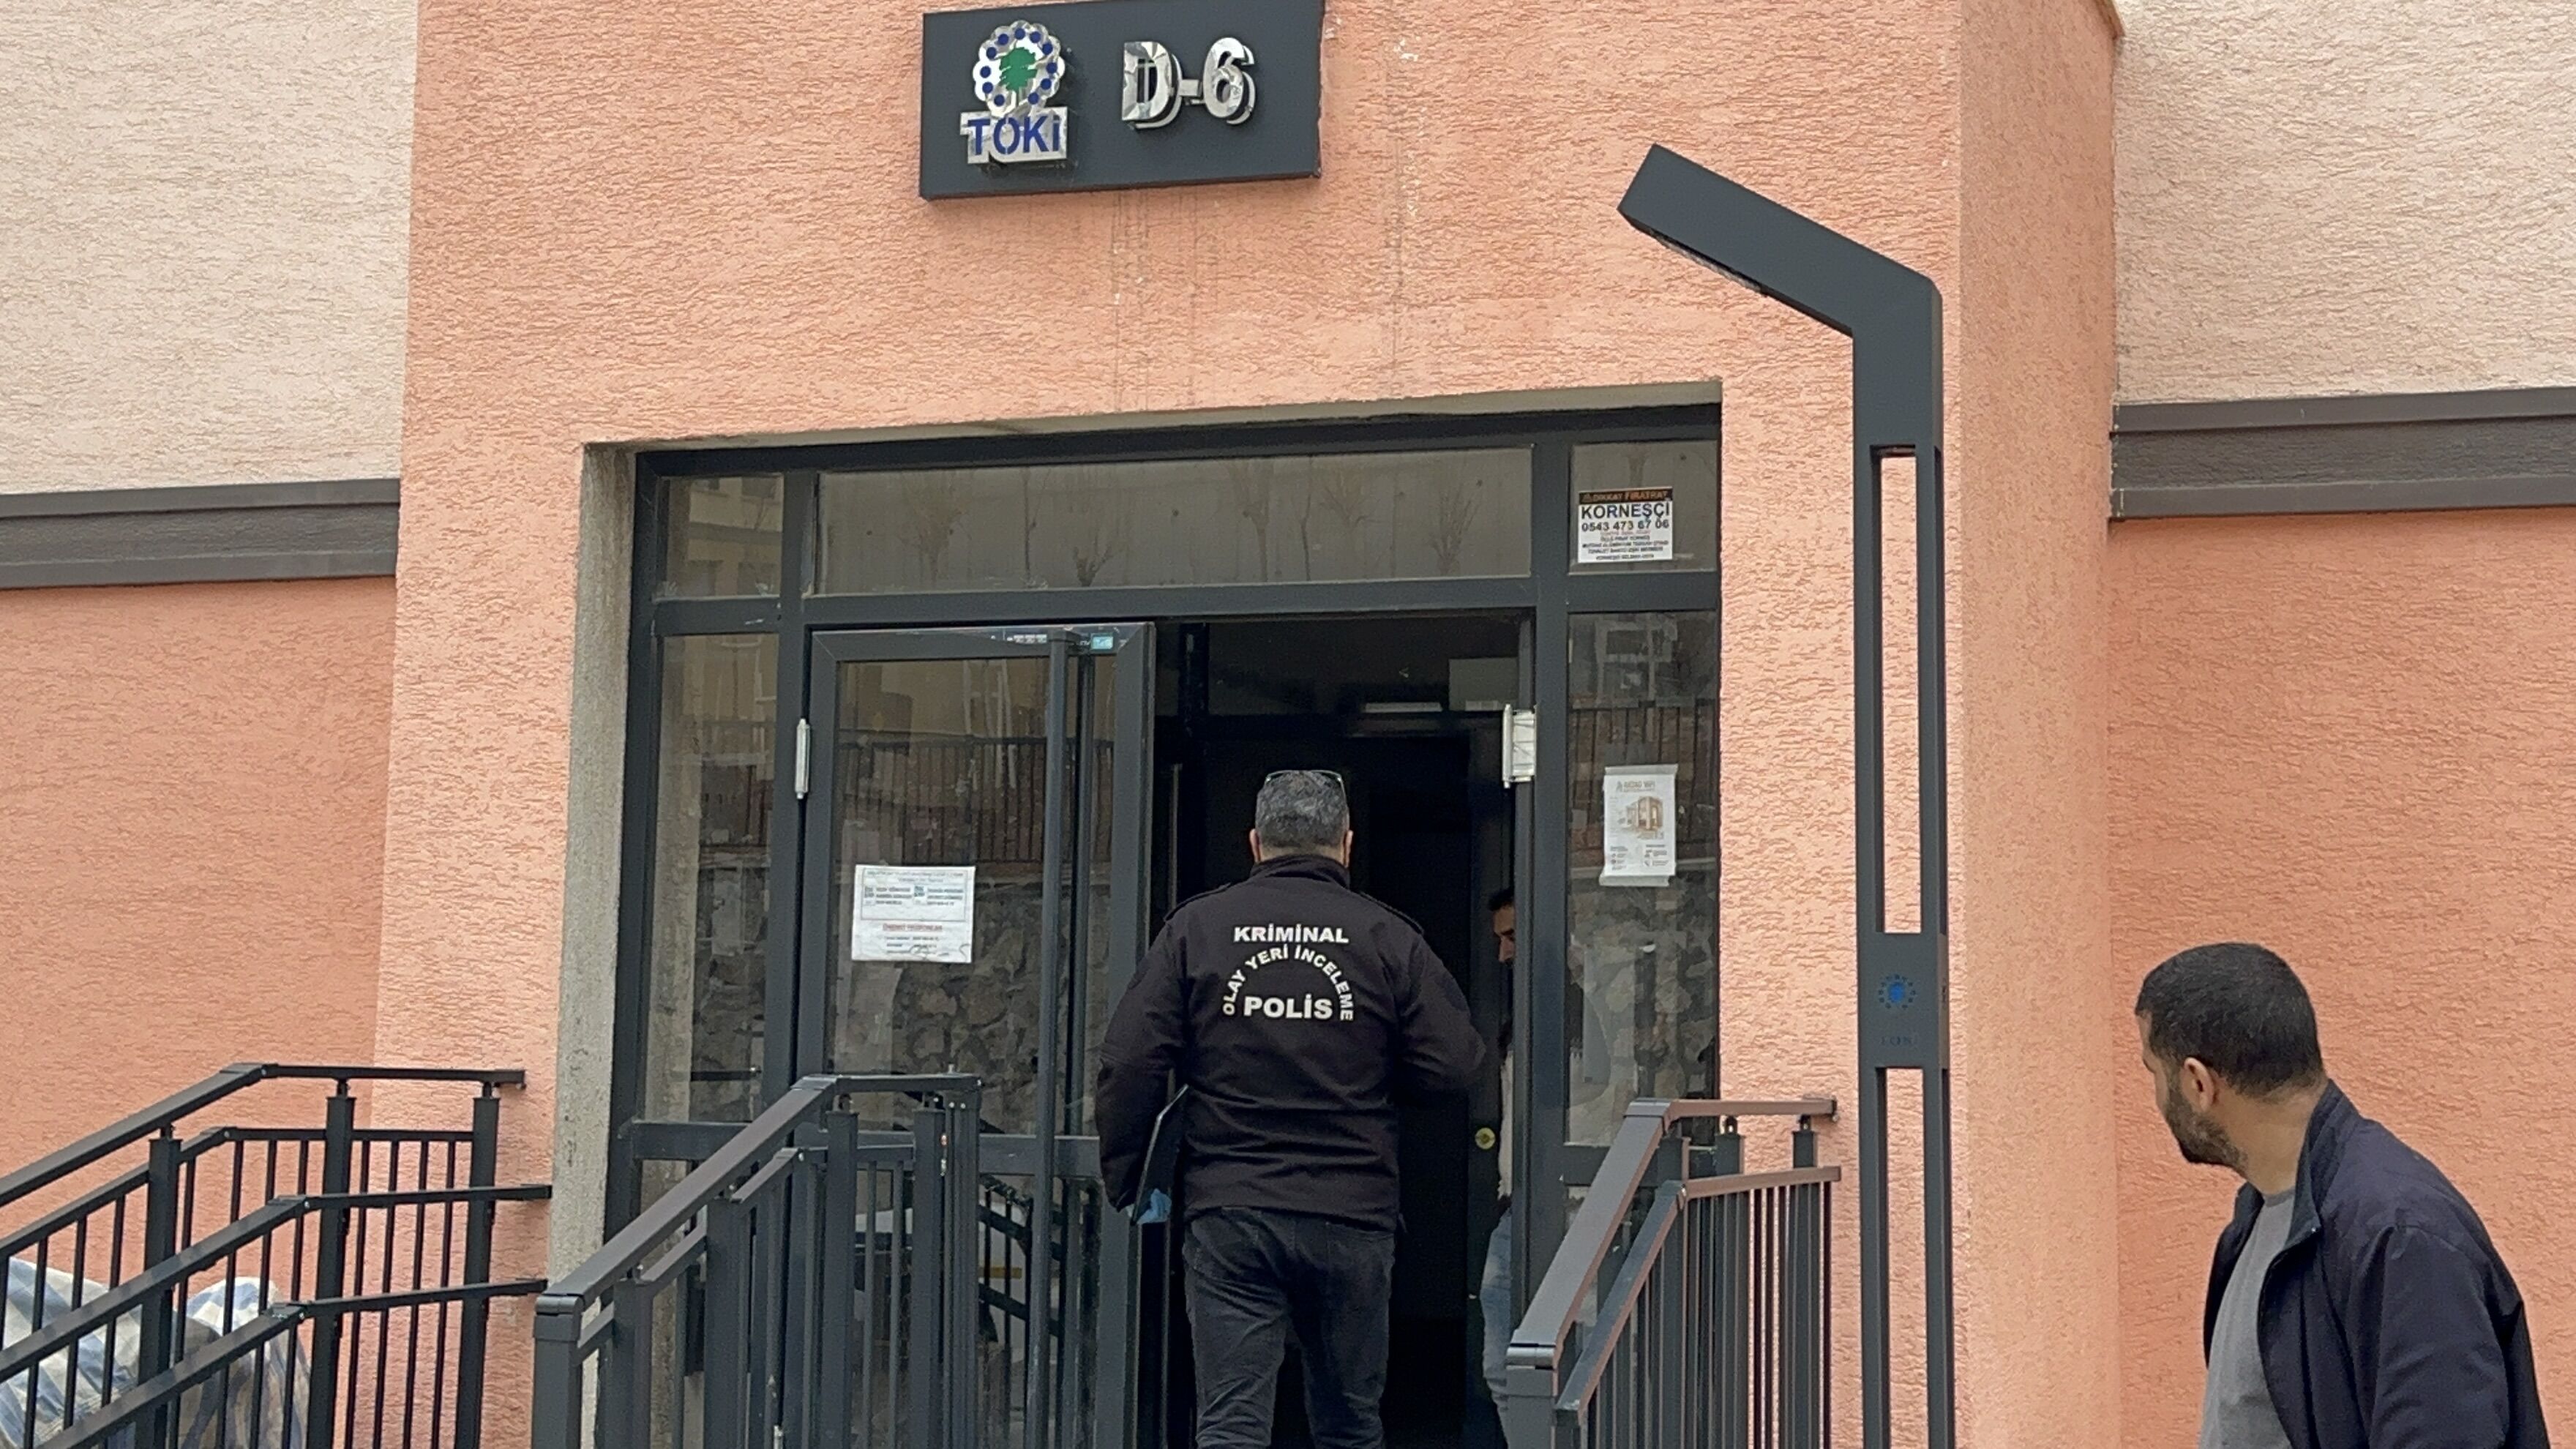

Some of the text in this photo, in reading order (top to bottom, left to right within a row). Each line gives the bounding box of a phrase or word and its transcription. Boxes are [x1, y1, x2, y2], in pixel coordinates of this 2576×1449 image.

[1121, 37, 1255, 128] D-6
[1581, 499, 1670, 520] KORNEŞÇİ
[1581, 519, 1670, 532] 0543 473 67 06
[1234, 924, 1349, 943] KRİMİNAL
[1222, 943, 1353, 1021] OLAY YERİ İNCELEME
[1244, 994, 1333, 1019] POLİS
